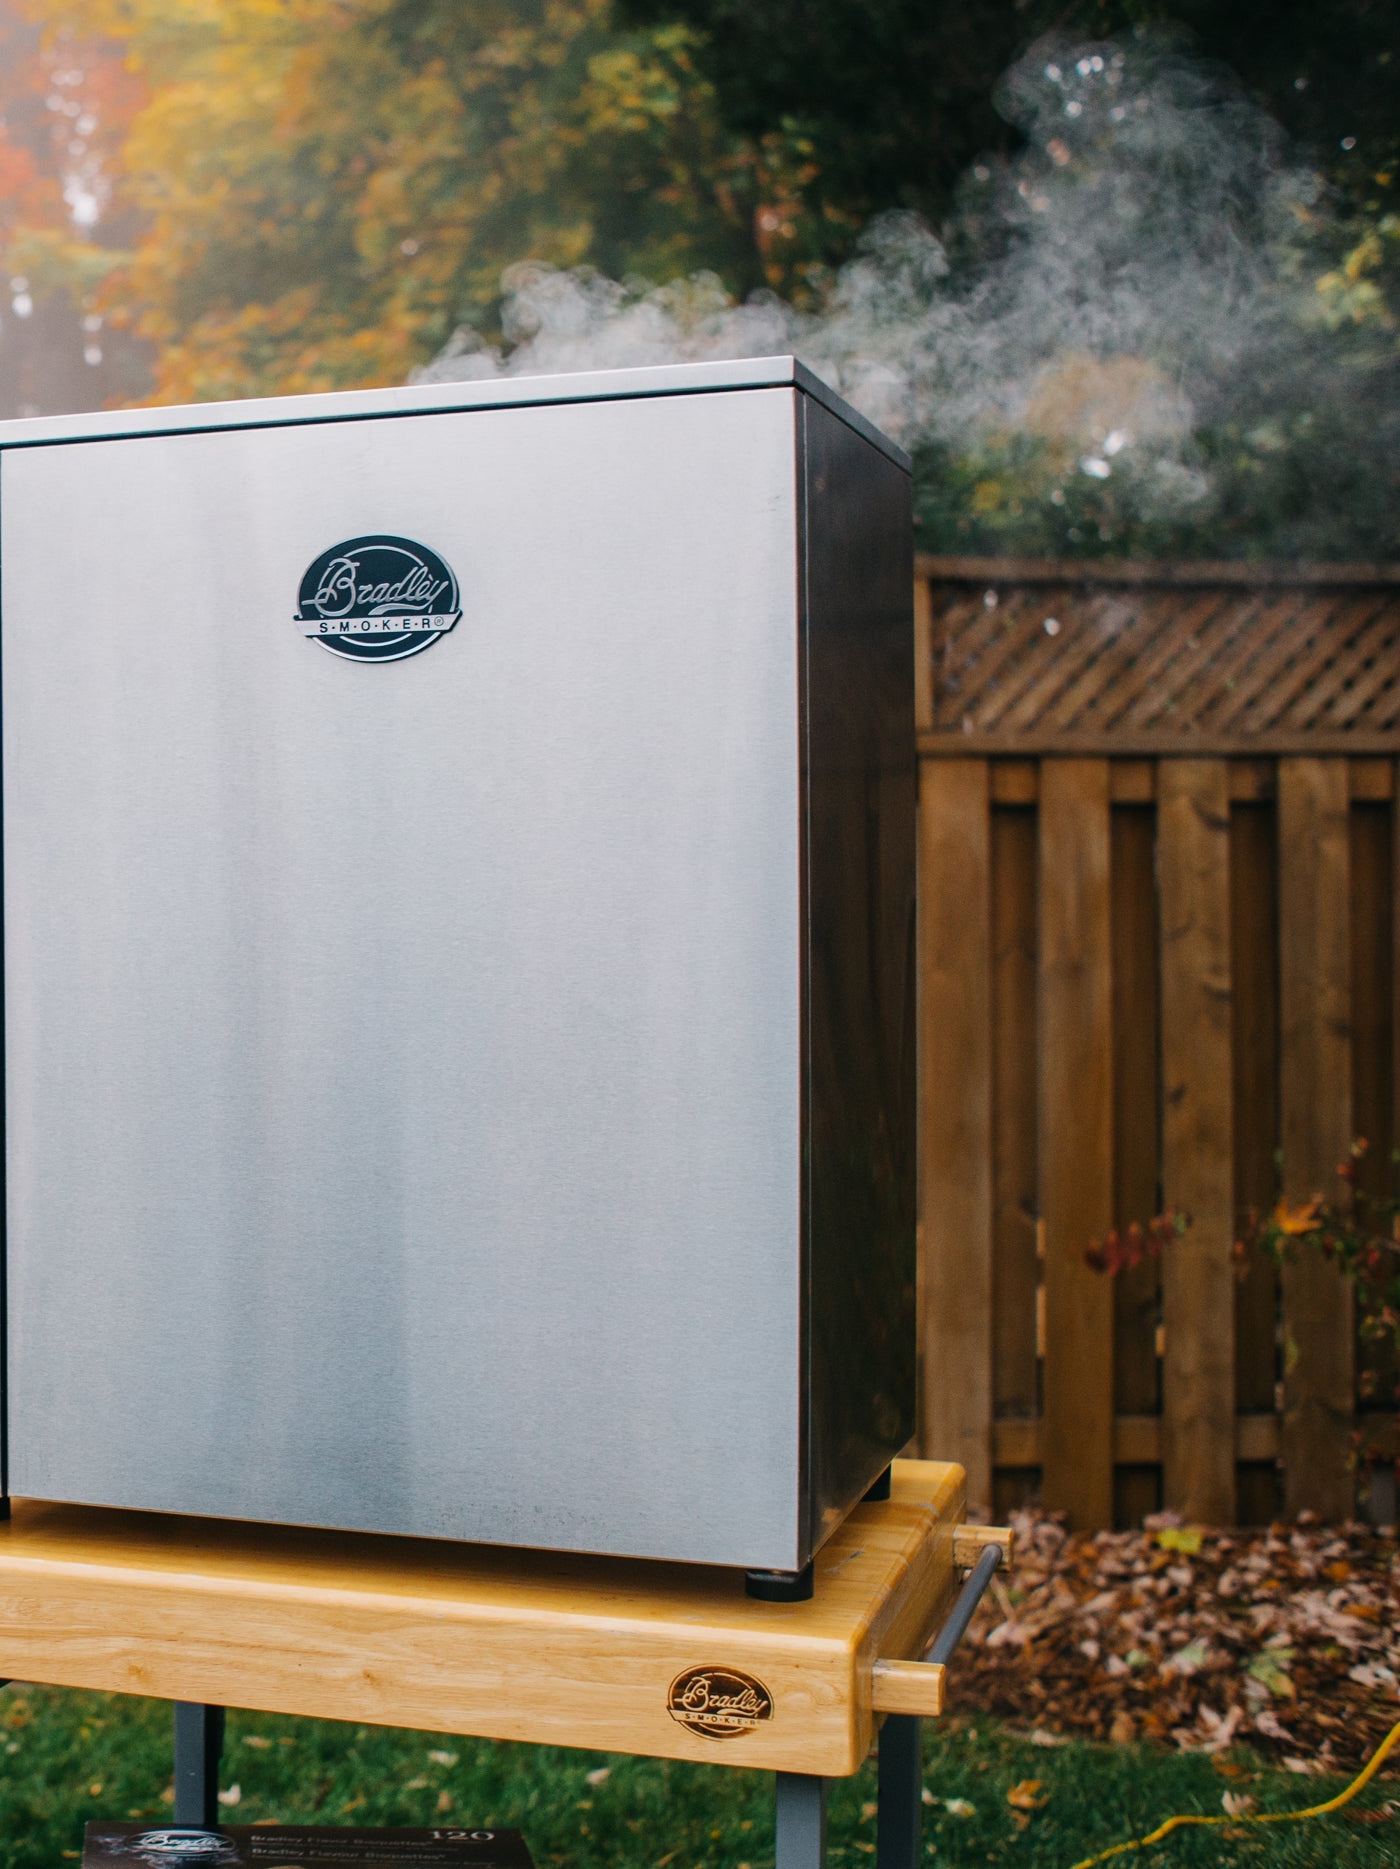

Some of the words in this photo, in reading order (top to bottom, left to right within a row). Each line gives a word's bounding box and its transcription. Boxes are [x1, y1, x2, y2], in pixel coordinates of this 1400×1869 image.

[301, 556, 450, 617] Bradley
[673, 1676, 769, 1718] Bradley
[430, 1830, 496, 1841] 120
